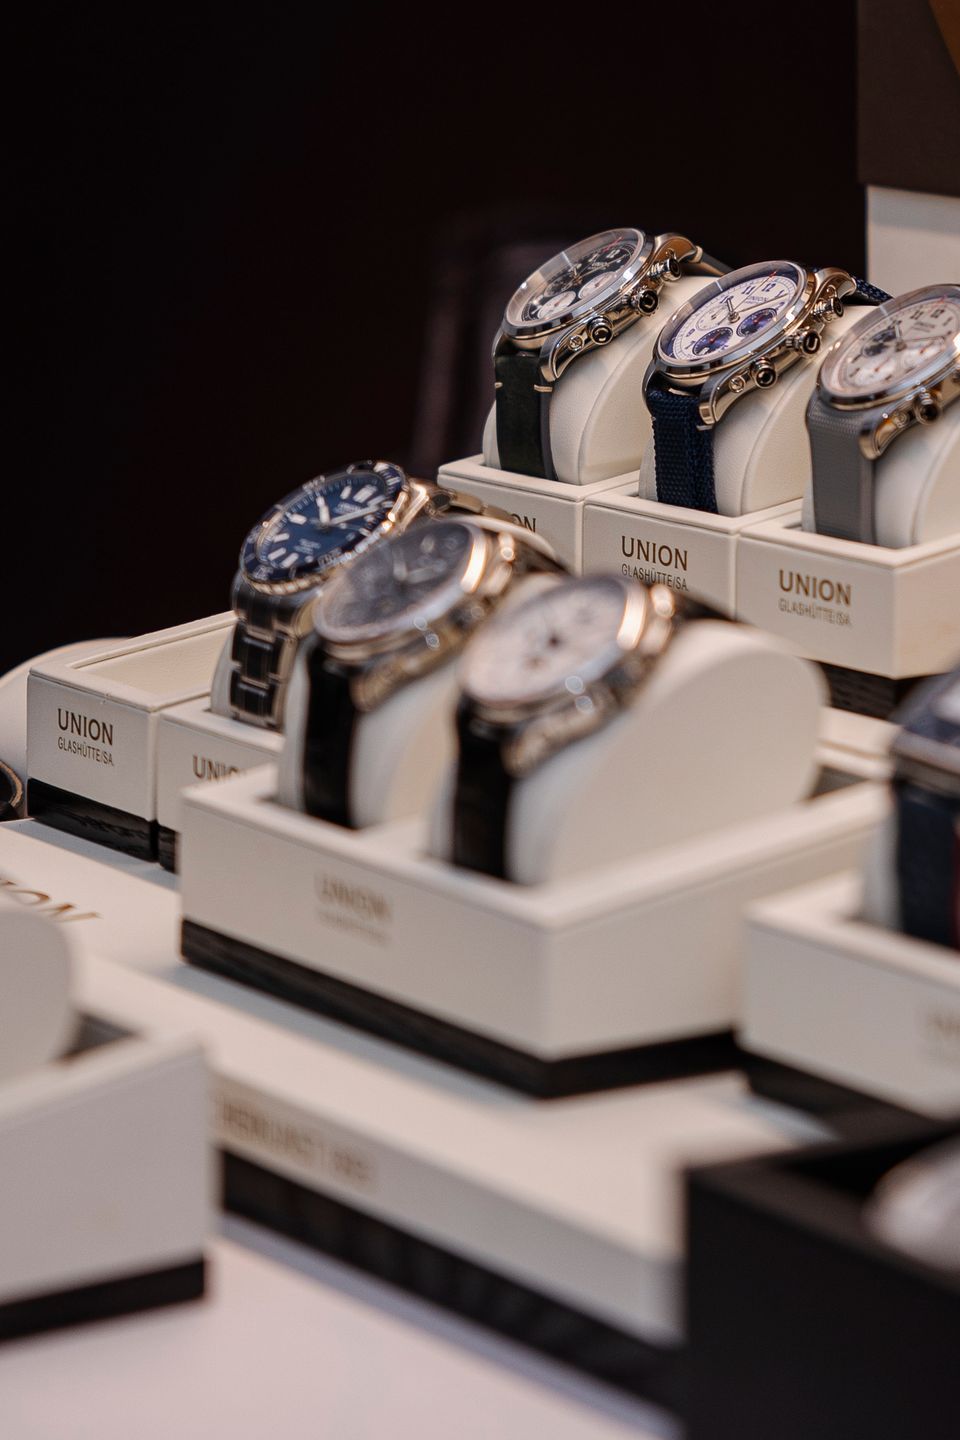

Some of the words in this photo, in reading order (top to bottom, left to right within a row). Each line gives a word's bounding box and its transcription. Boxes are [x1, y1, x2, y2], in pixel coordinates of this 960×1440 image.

[621, 535, 688, 572] UNION
[779, 569, 852, 608] UNION
[58, 708, 113, 746] UNION
